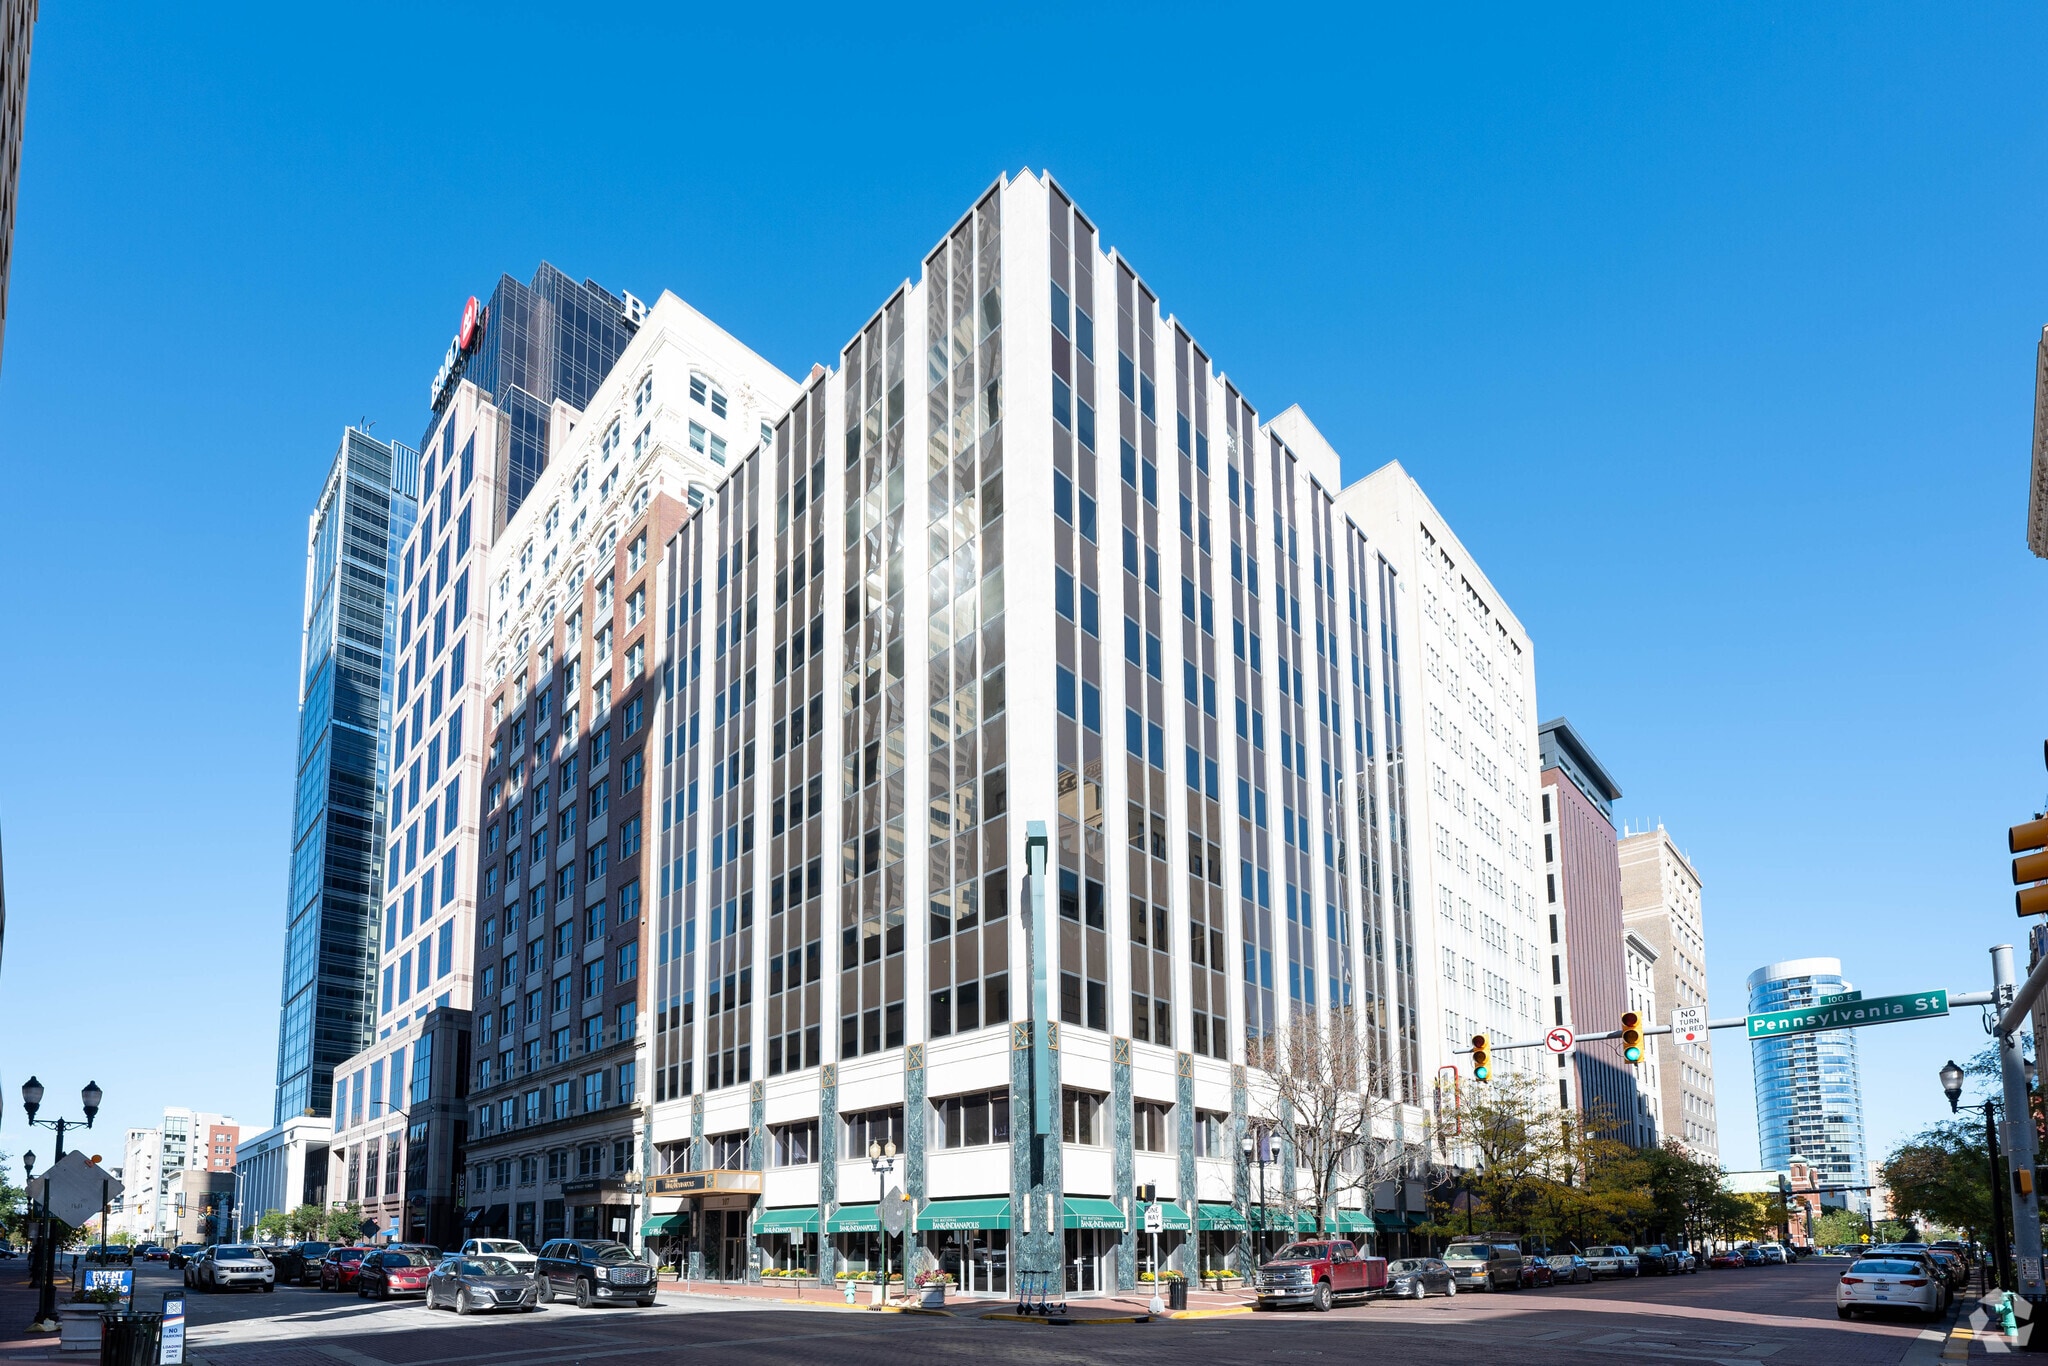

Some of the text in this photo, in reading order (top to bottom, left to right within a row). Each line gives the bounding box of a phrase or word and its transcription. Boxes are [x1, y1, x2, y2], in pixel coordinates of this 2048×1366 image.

[1828, 993, 1853, 1004] 100 E
[1681, 1009, 1696, 1018] NO
[1753, 996, 1940, 1032] Pennsylvania St
[1679, 1018, 1700, 1026] TURN
[1689, 1024, 1704, 1032] RED
[92, 1270, 125, 1279] EVENT
